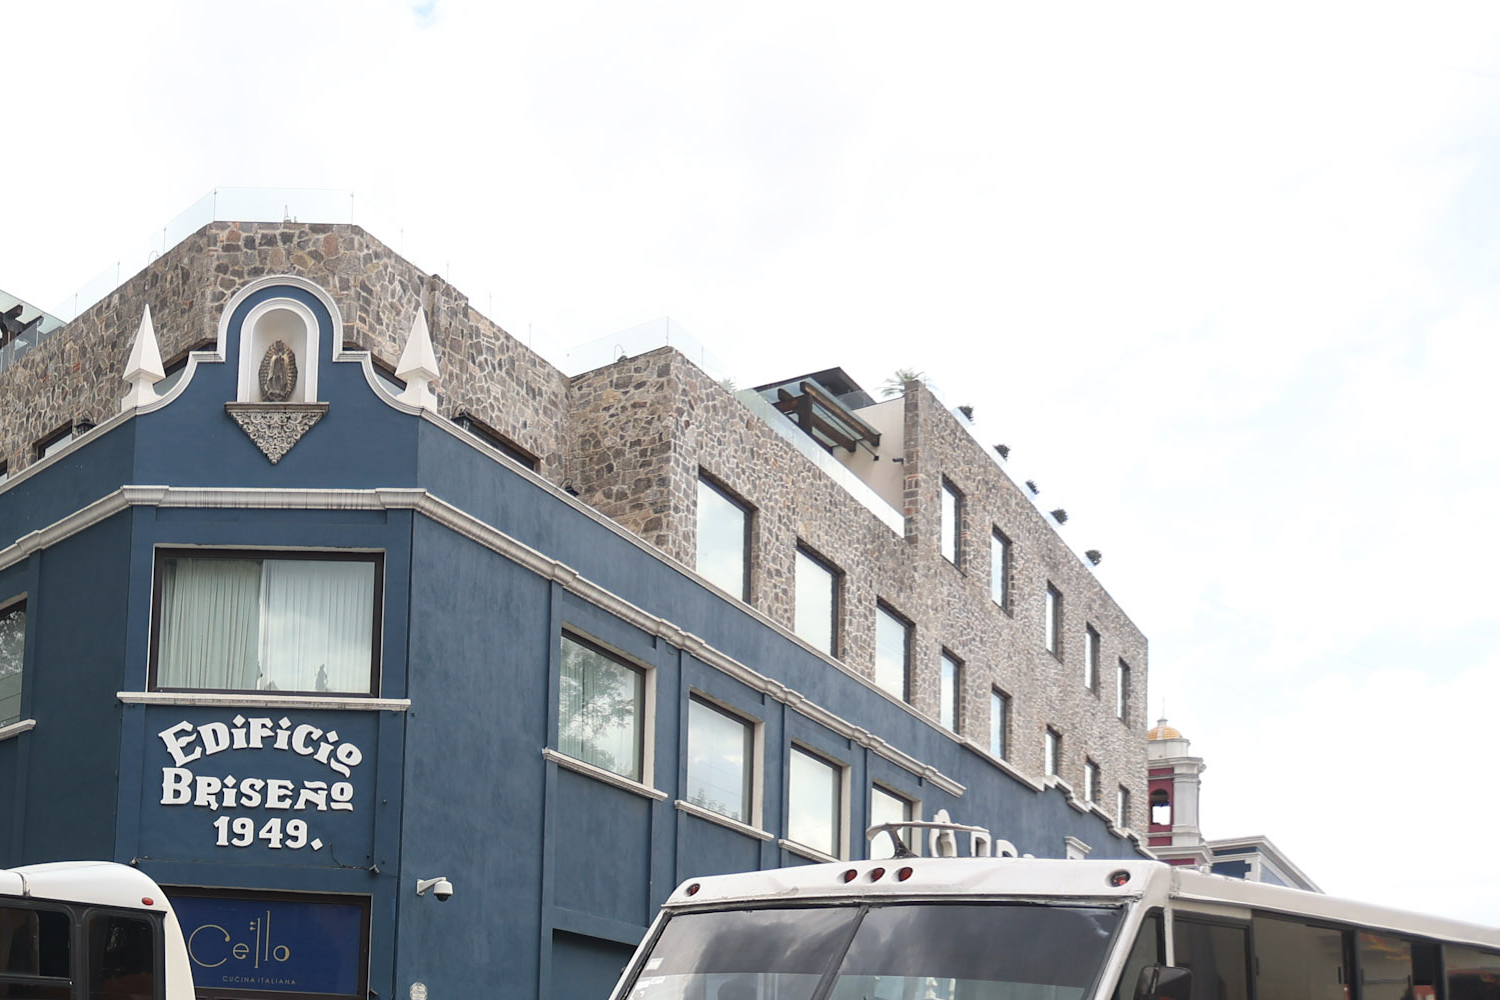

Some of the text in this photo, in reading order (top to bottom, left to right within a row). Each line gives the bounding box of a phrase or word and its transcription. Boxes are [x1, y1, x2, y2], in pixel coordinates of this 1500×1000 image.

[213, 815, 323, 850] 1949.
[188, 910, 290, 968] Cello
[222, 975, 297, 985] CUCINA ITALIANA
